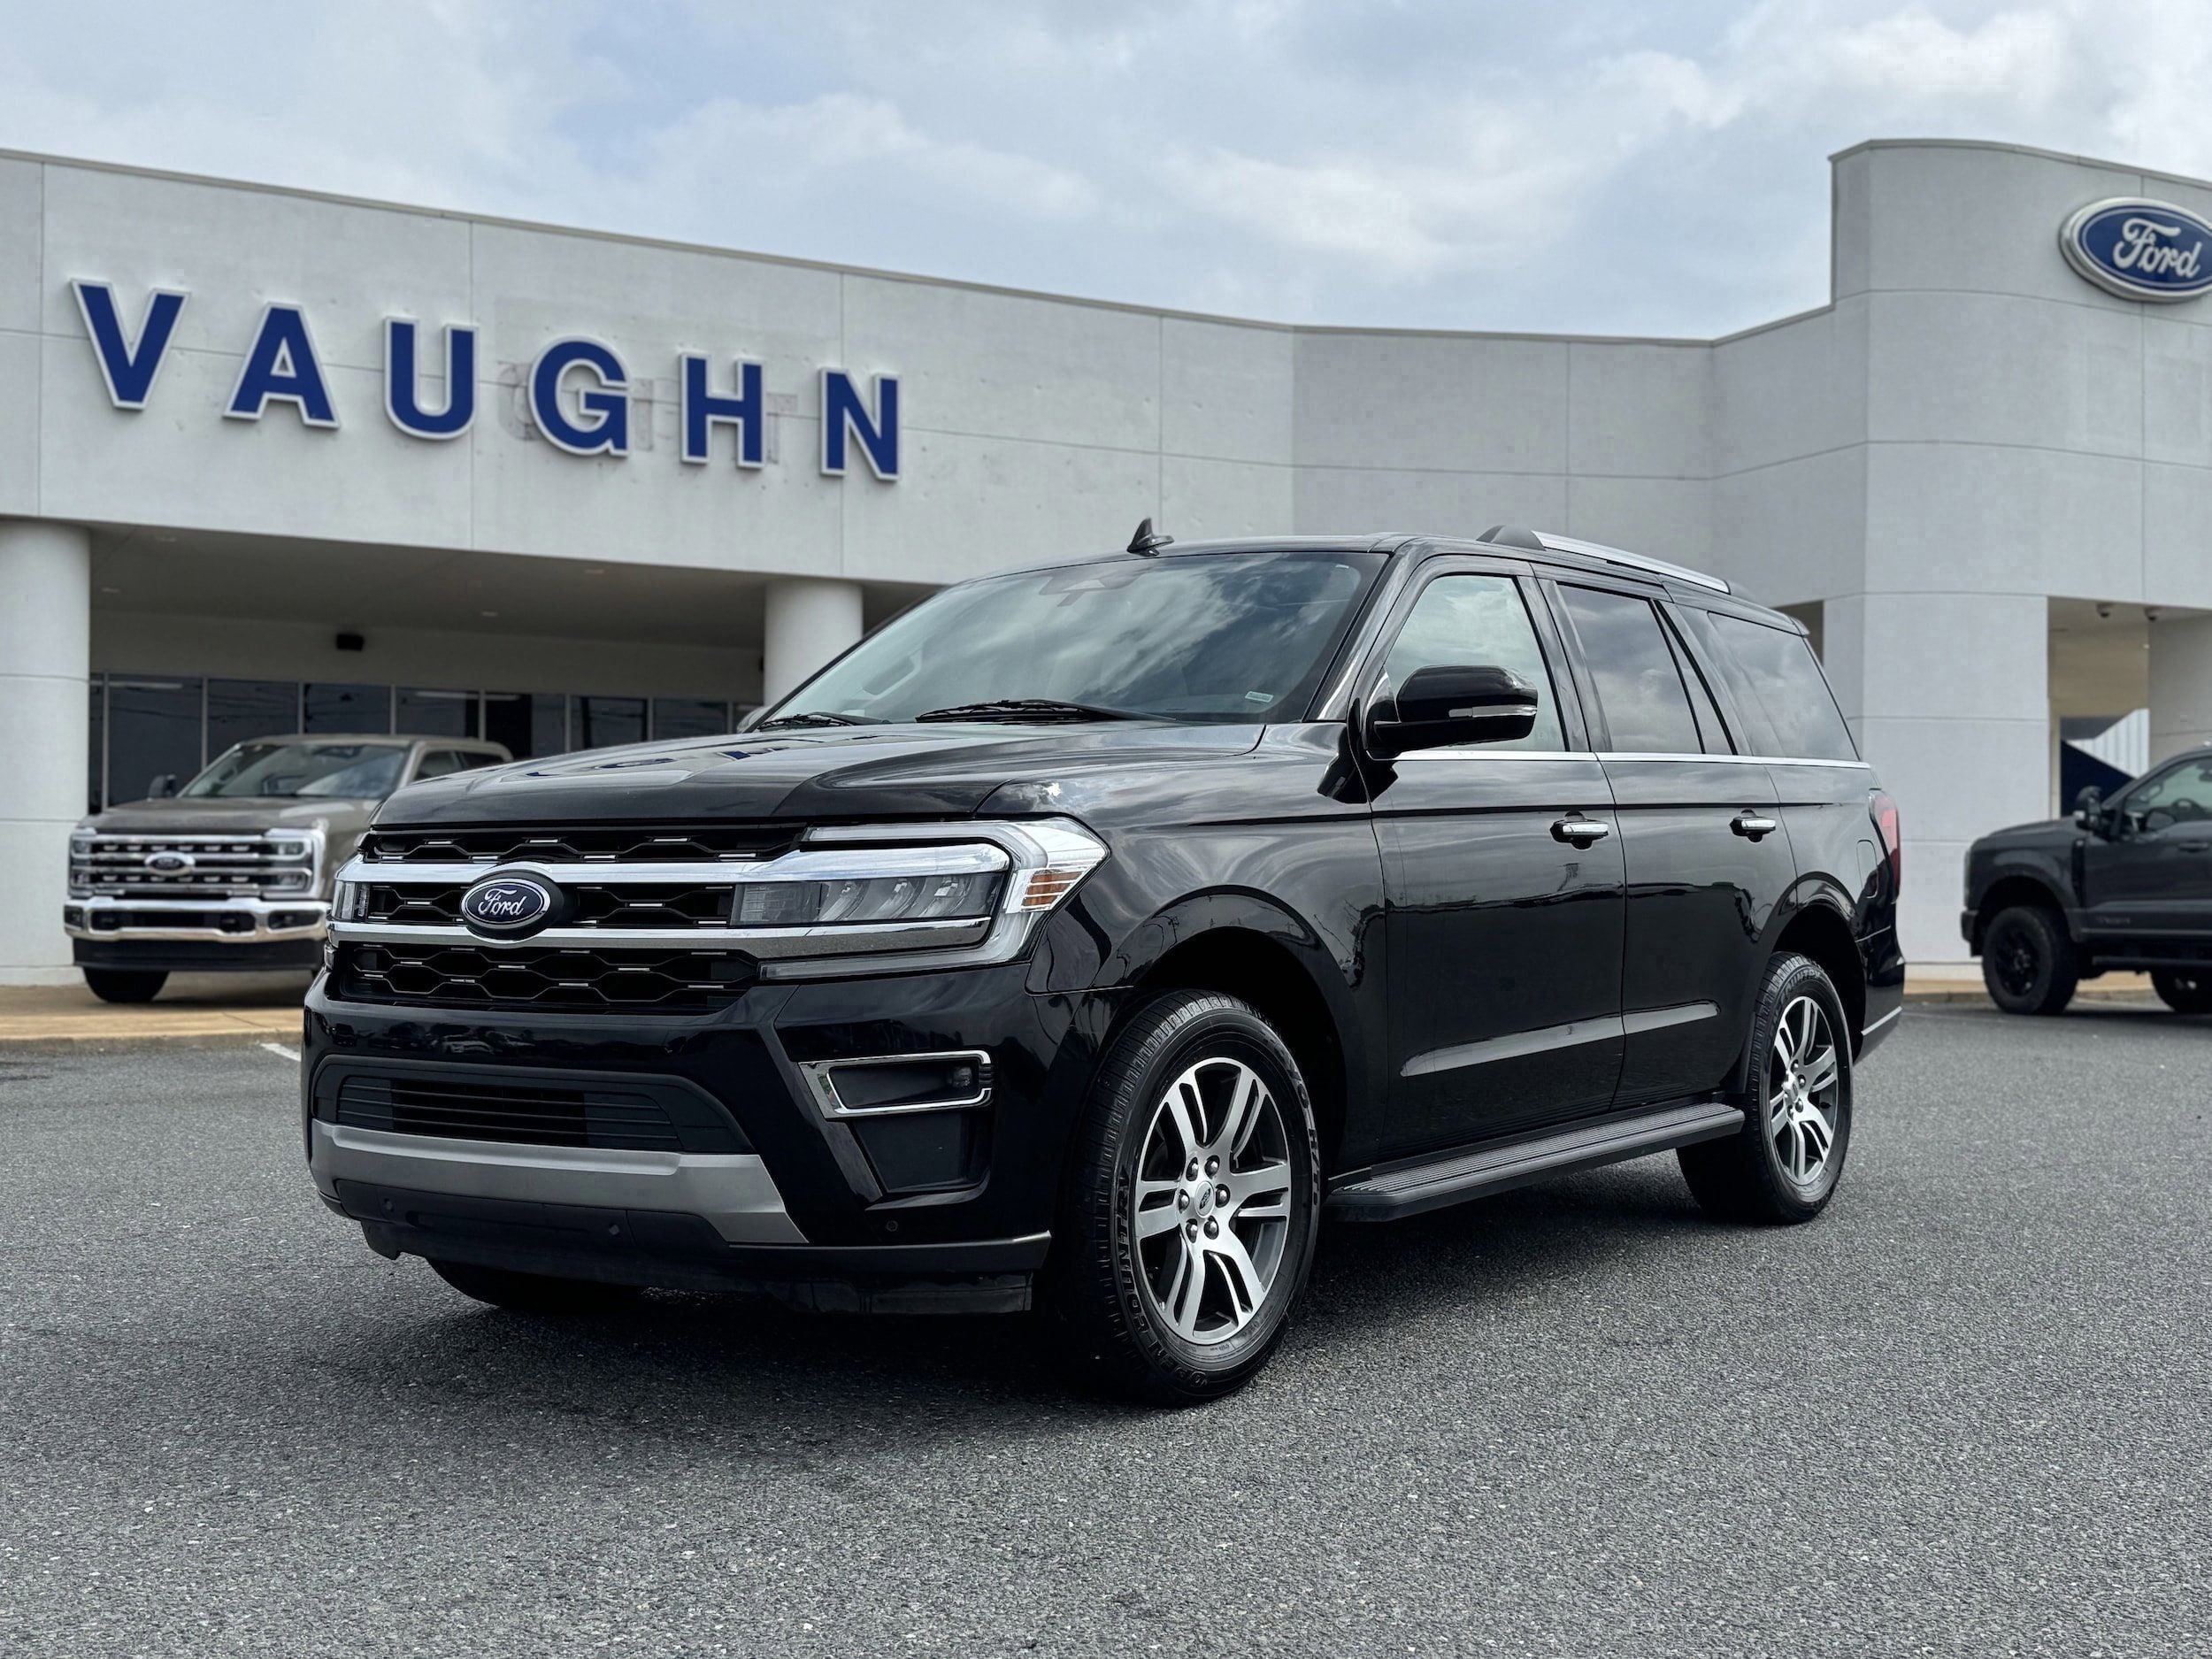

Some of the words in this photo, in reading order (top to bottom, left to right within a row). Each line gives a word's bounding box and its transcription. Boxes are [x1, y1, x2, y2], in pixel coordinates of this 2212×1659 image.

[2113, 218, 2202, 278] Ford
[71, 279, 902, 481] VAUGHN
[478, 887, 527, 916] Ford
[1116, 1165, 1150, 1333] COUNTRY
